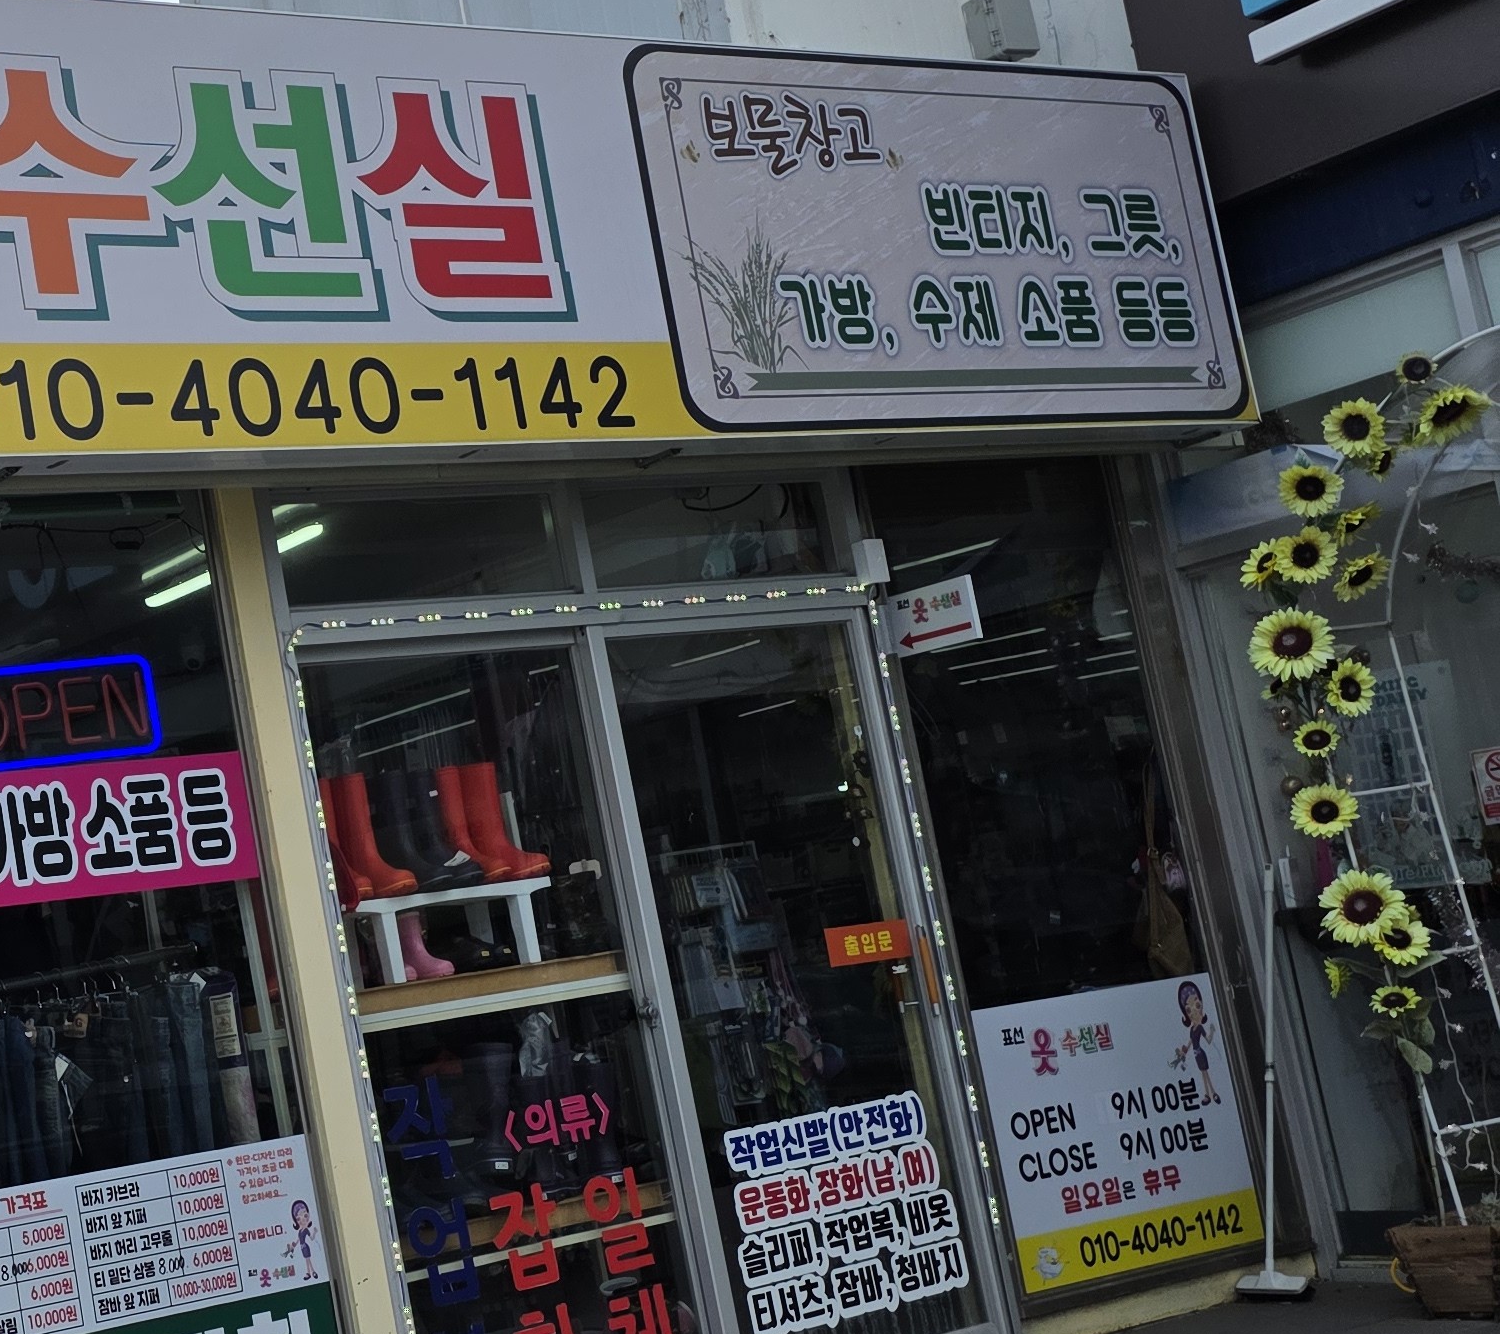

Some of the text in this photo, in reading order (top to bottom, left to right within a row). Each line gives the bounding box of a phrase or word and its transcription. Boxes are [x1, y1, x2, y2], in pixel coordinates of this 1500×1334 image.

[703, 94, 881, 176] 보물창고
[924, 187, 1180, 260] 빈티지, 그릇,
[779, 279, 1195, 351] 가방, 수제 소품 등등
[85, 772, 179, 872] 소품
[182, 768, 236, 868] 등
[844, 930, 893, 956] 출입문
[1001, 1022, 1114, 1076] 표선 옷 수선실
[1111, 1078, 1200, 1120] 9시 00분
[1010, 1102, 1077, 1140] OPEN
[1120, 1118, 1209, 1160] 9시 00분
[237, 1166, 260, 1177] 가격이
[1019, 1141, 1098, 1182] CLOSE
[0, 1191, 48, 1215] 가격표
[81, 1167, 220, 1206] 바지 카브라 10,000원
[239, 1180, 247, 1190] 수
[1061, 1164, 1182, 1214] 일요일은 휴무
[85, 1193, 224, 1234] 바지 앞 지퍼 10,000원
[22, 1223, 66, 1247] 5,000원
[89, 1219, 229, 1261] 바지 허리 고무줄 10,000원
[742, 1193, 953, 1279] 슬리퍼, 작업복, 비옷
[1079, 1203, 1244, 1268] 010-4040-1142
[27, 1250, 70, 1273] 6,000원
[94, 1271, 105, 1288] 티
[108, 1266, 131, 1285] 밑단
[133, 1260, 156, 1281] 삼봉
[193, 1245, 233, 1268] 6,000원
[31, 1277, 73, 1302] 6,000원
[98, 1272, 237, 1316] 잠바 앞 지퍼 10,000-30,000원
[752, 1242, 964, 1332] 티셔츠, 잠바, 청바지
[27, 1305, 78, 1330] 10,000원
